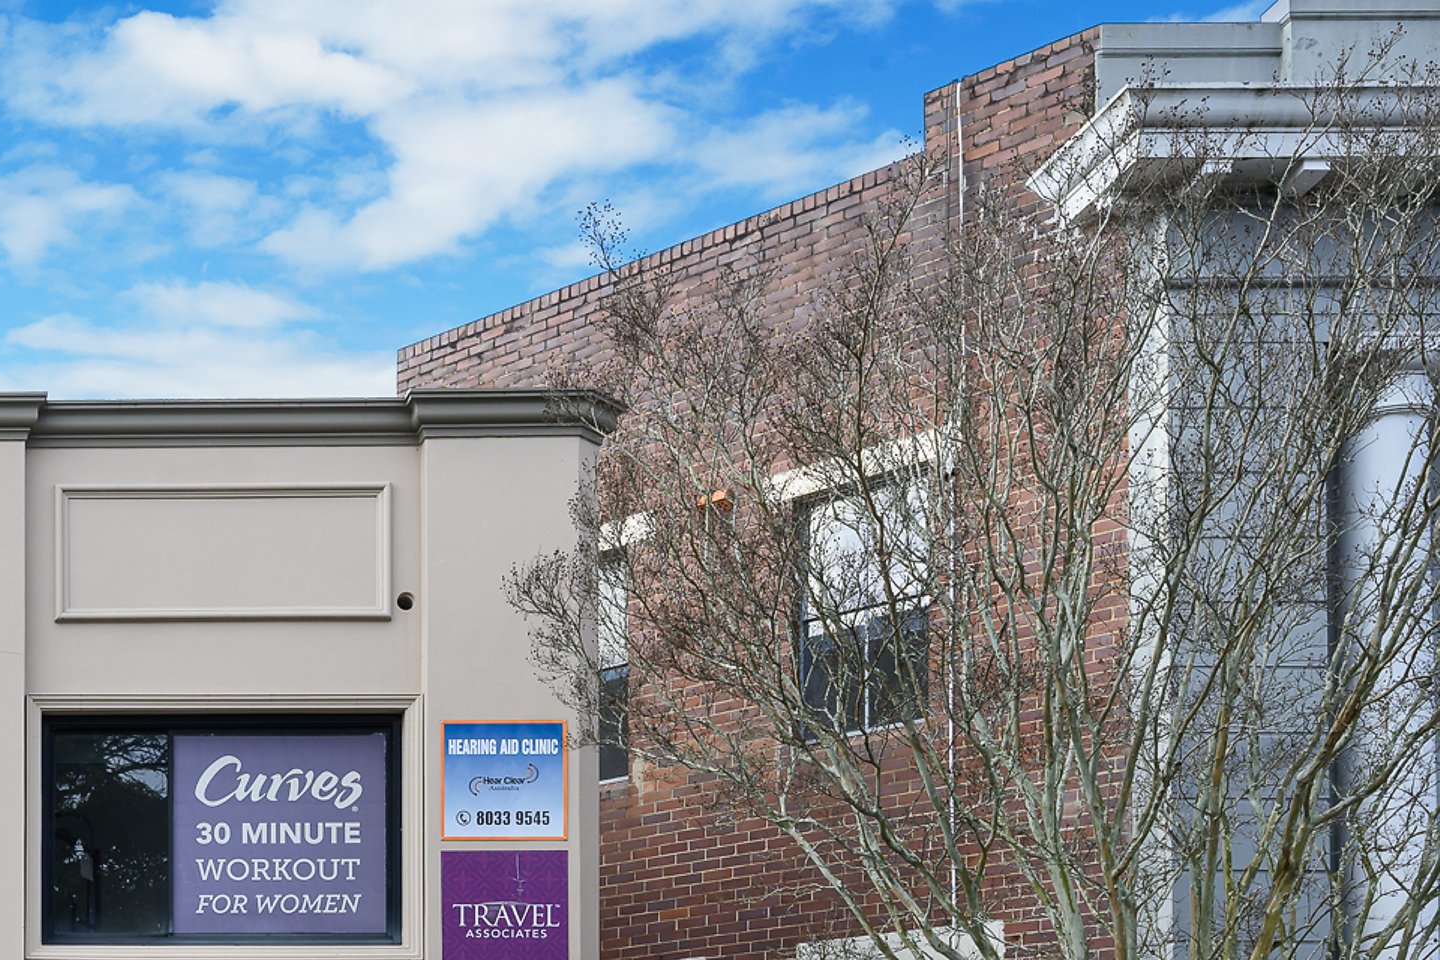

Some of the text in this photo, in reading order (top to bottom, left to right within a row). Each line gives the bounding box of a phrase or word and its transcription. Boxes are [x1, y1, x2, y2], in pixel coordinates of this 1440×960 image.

[448, 739, 559, 755] HEARING AID CLINIC
[194, 755, 363, 809] Curves
[476, 811, 550, 825] 8033 9545
[195, 822, 361, 844] 30 MINUTE
[195, 858, 361, 881] WORKOUT
[195, 894, 362, 914] FOR WOMEN
[452, 903, 560, 927] TRAVEL
[465, 929, 548, 938] ASSOCIATES
